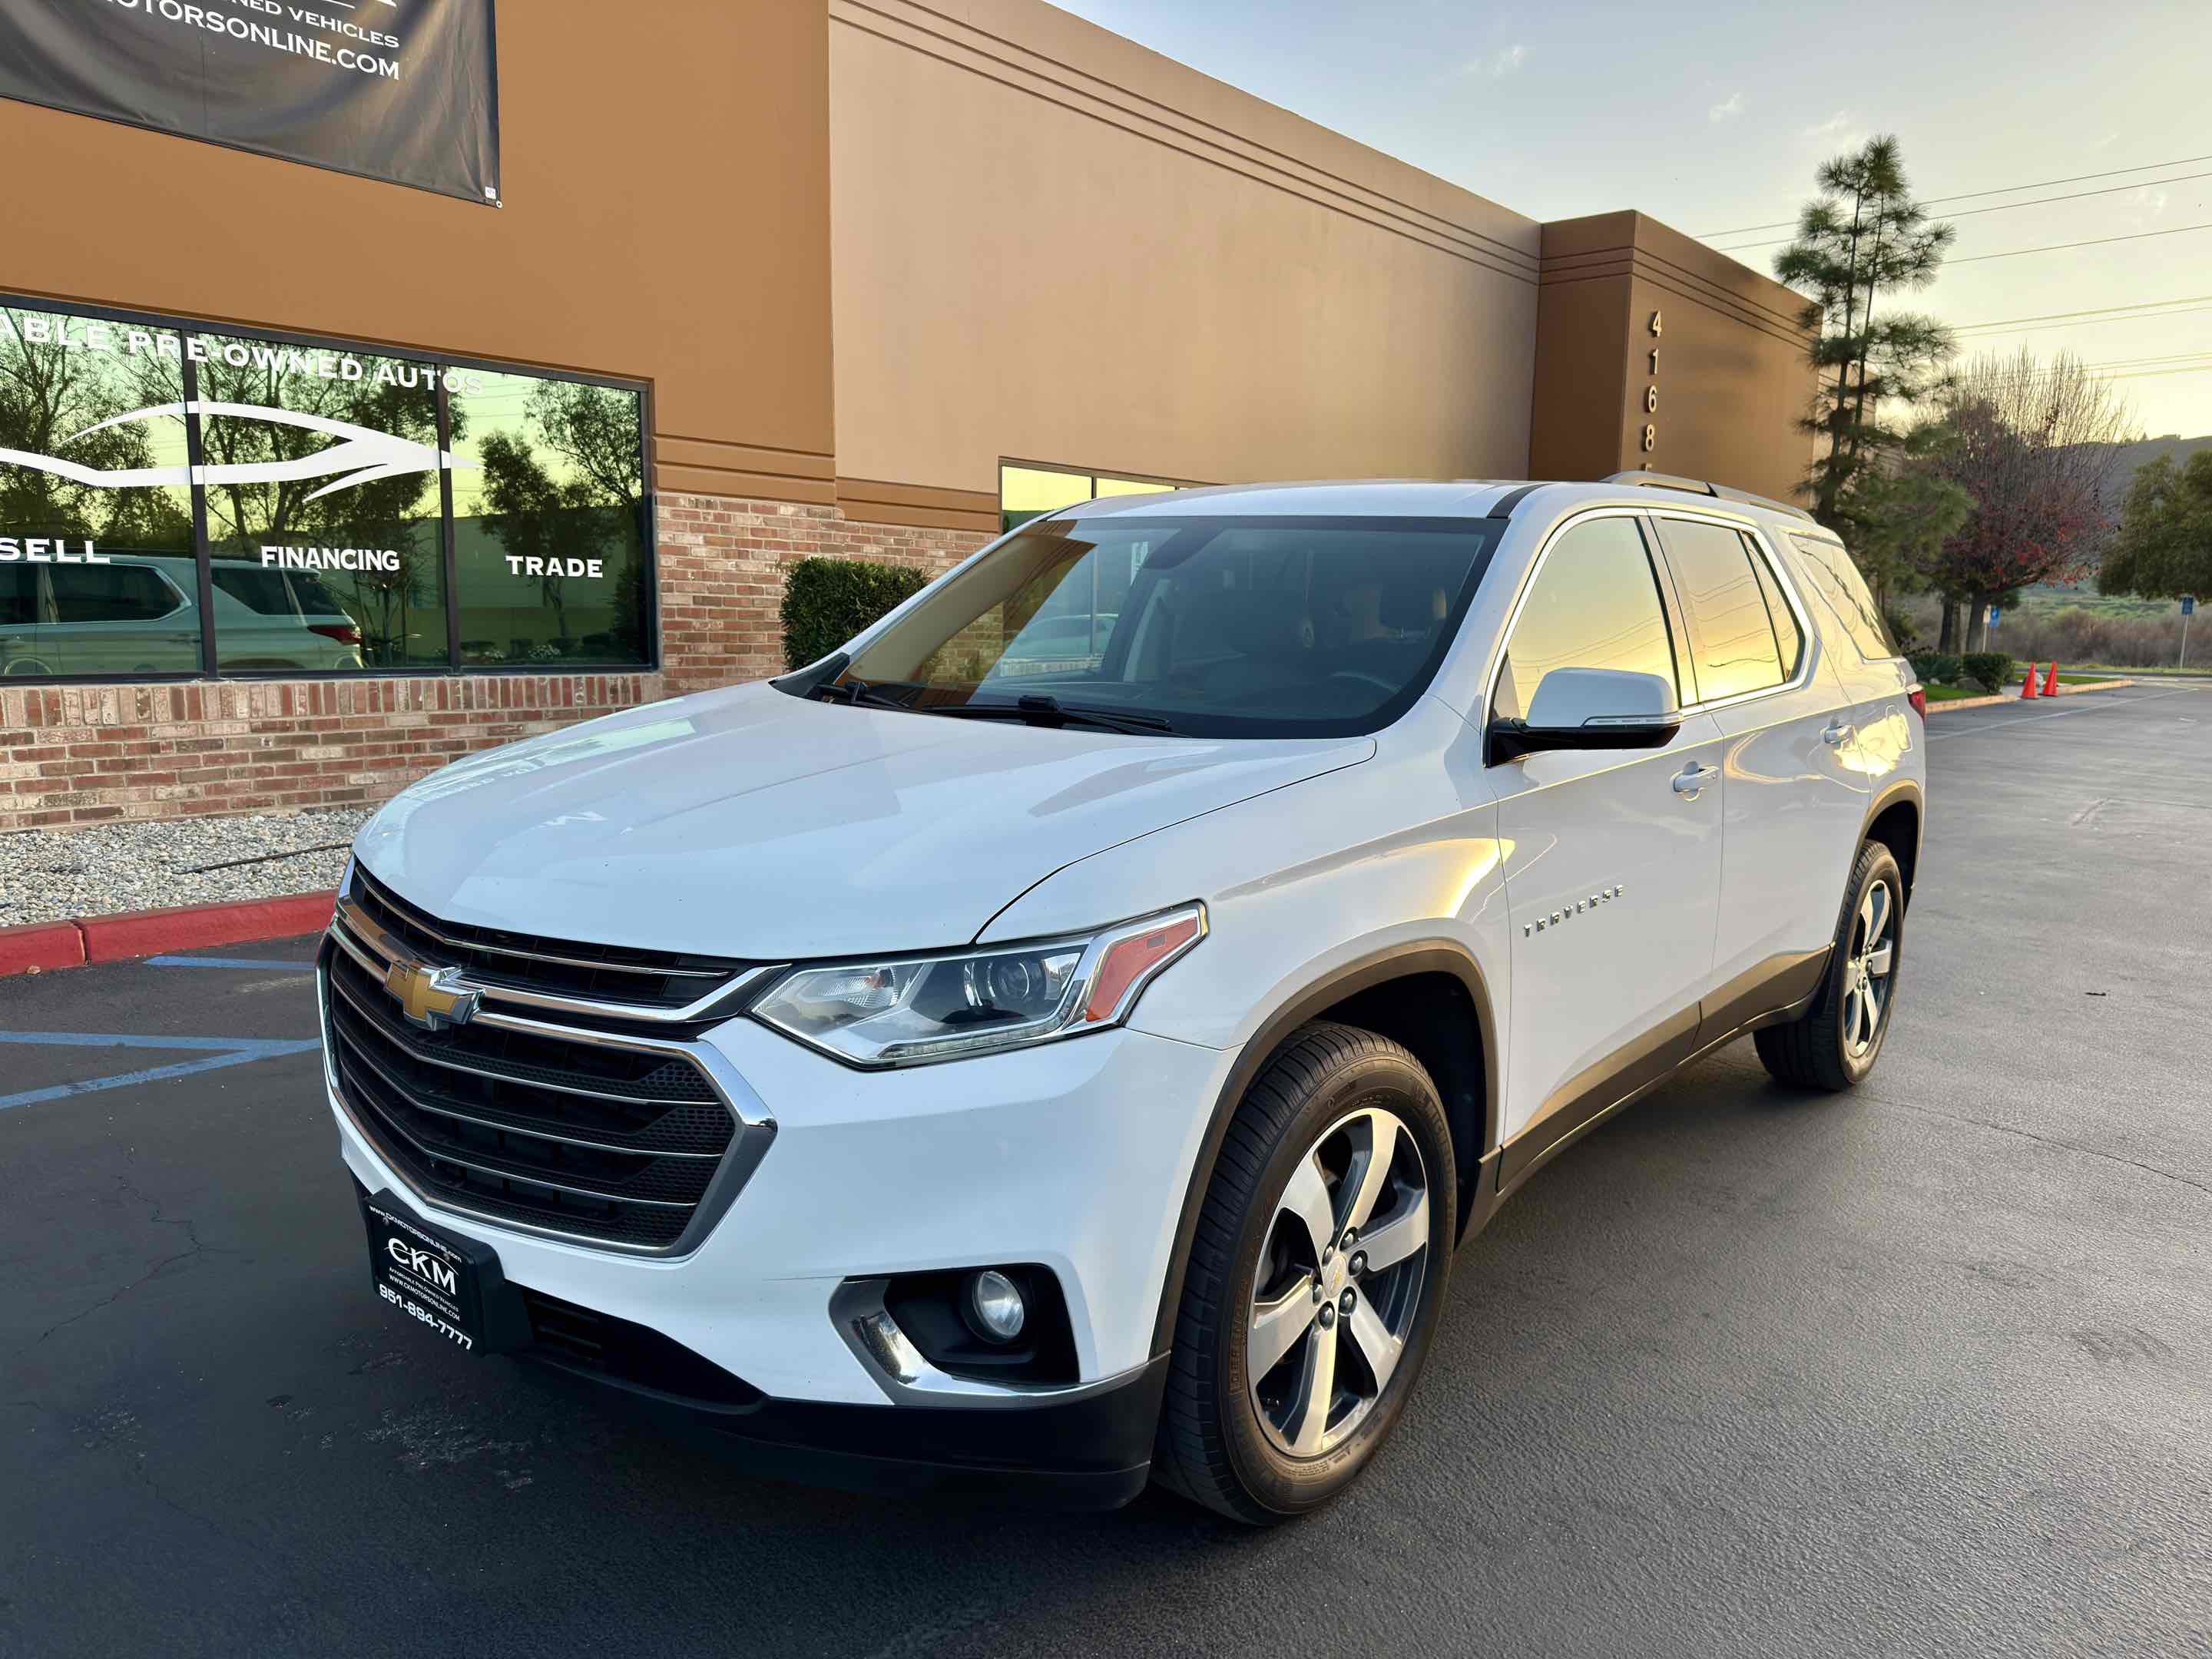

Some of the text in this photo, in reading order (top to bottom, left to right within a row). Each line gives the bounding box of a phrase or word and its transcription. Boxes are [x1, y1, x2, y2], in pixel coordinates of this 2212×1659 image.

[108, 0, 399, 80] TORSONLINE.COM
[287, 6, 399, 48] VEHICLES
[128, 330, 363, 381] PRE-OWNED
[377, 363, 484, 395] AUTOS
[1644, 310, 1662, 471] 4168
[0, 537, 111, 565] SELL
[260, 545, 400, 571] FINANCING
[505, 555, 603, 578] TRADE
[1523, 884, 1623, 938] TRAVERSE
[388, 1237, 456, 1296] CKM
[379, 1283, 473, 1350] 951-894-7777
